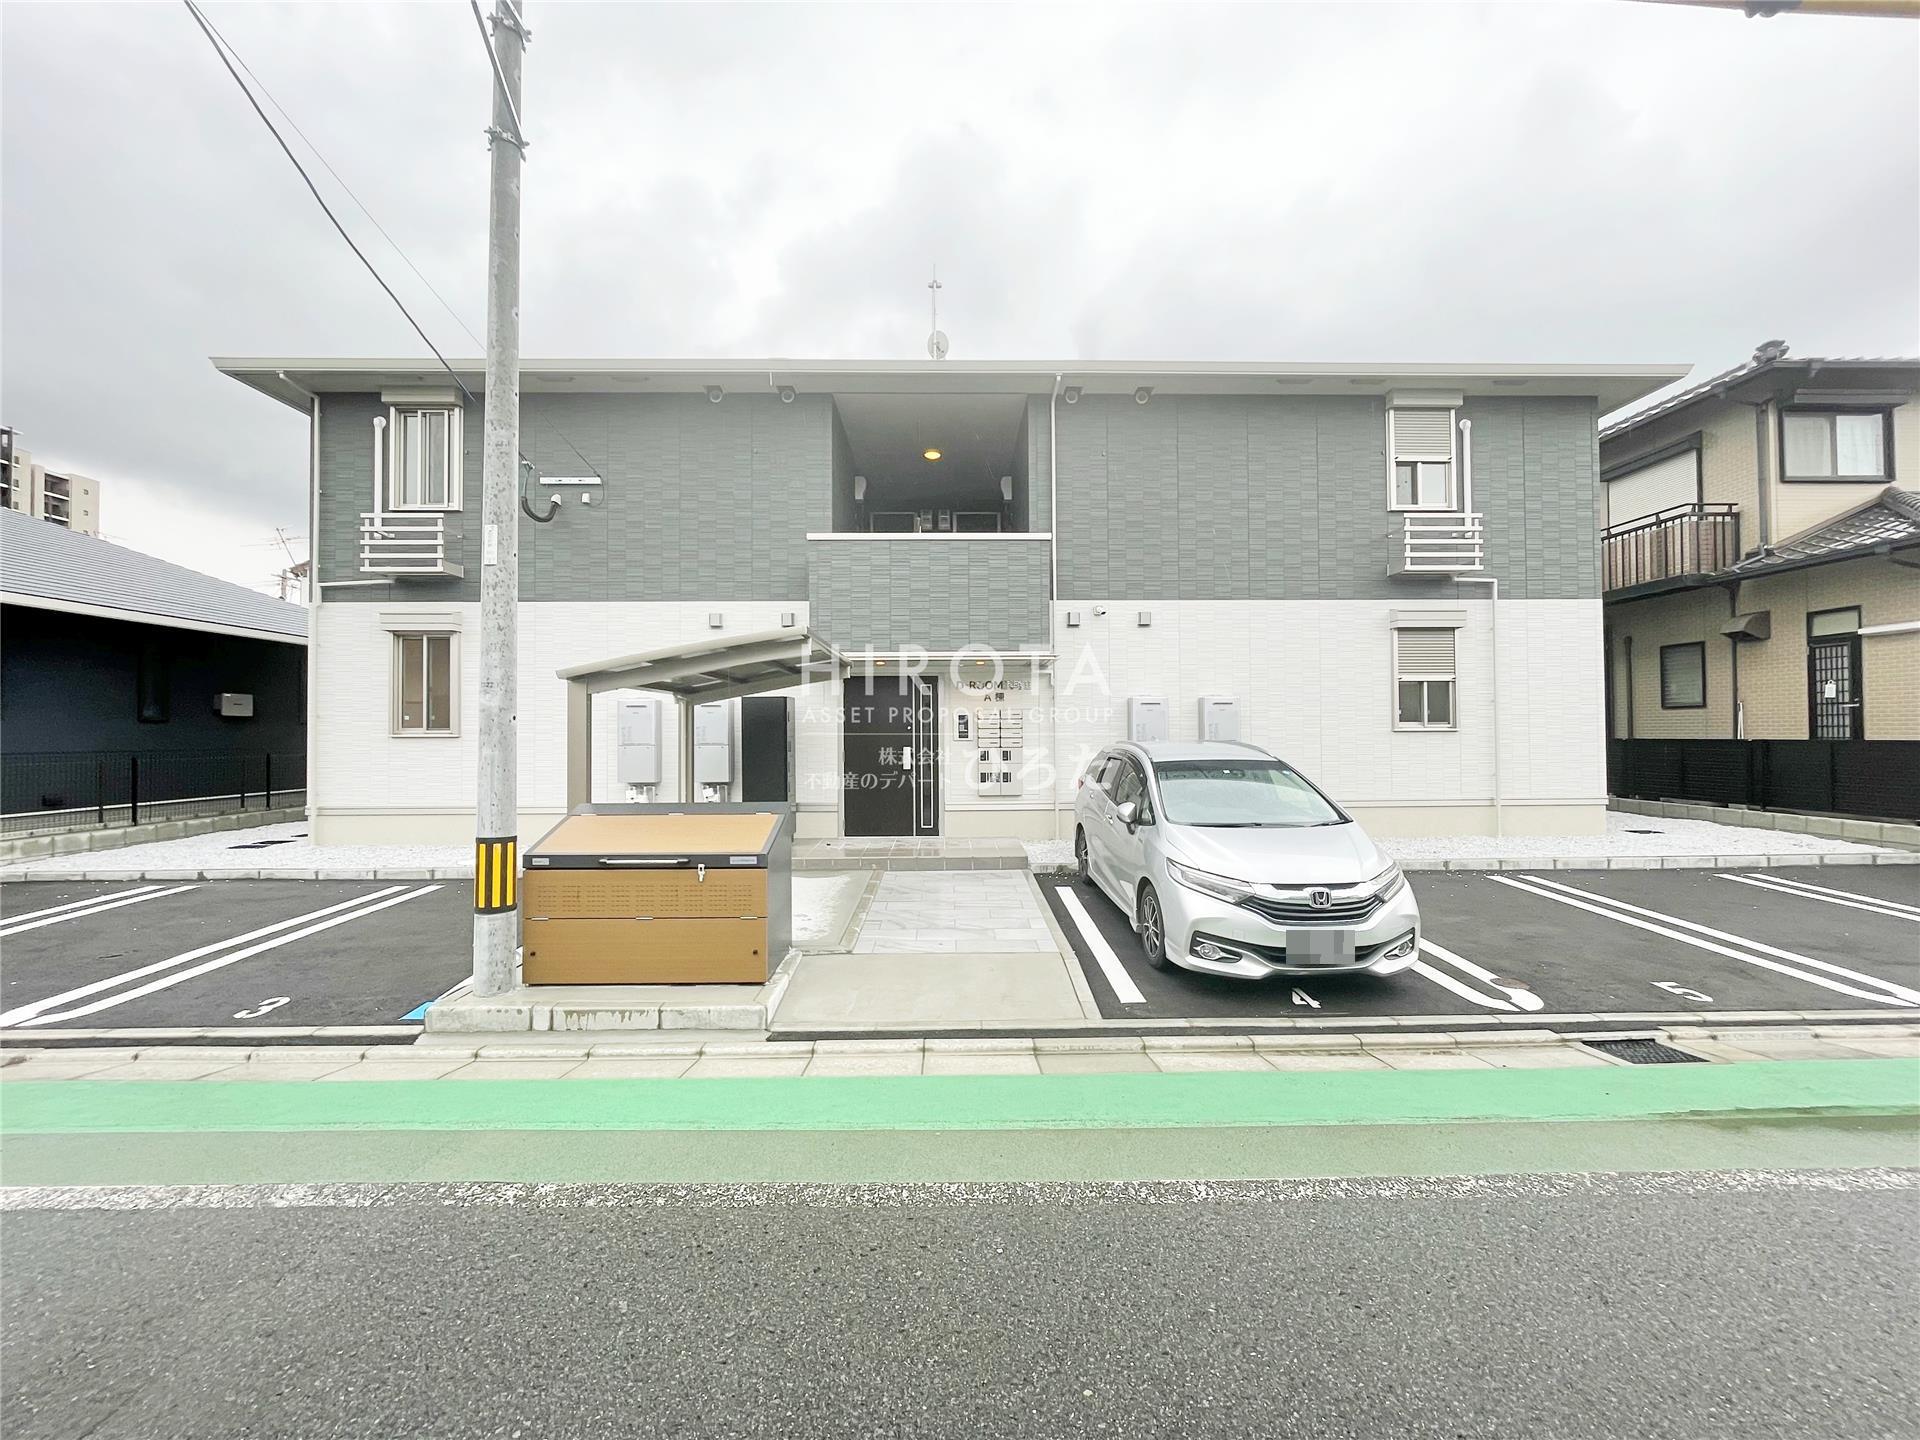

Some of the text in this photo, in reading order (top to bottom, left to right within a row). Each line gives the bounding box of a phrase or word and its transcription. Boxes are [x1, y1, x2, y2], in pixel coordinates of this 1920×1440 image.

[1291, 987, 1322, 1009] 4
[1649, 981, 1714, 1002] 5
[232, 996, 291, 1019] 3
